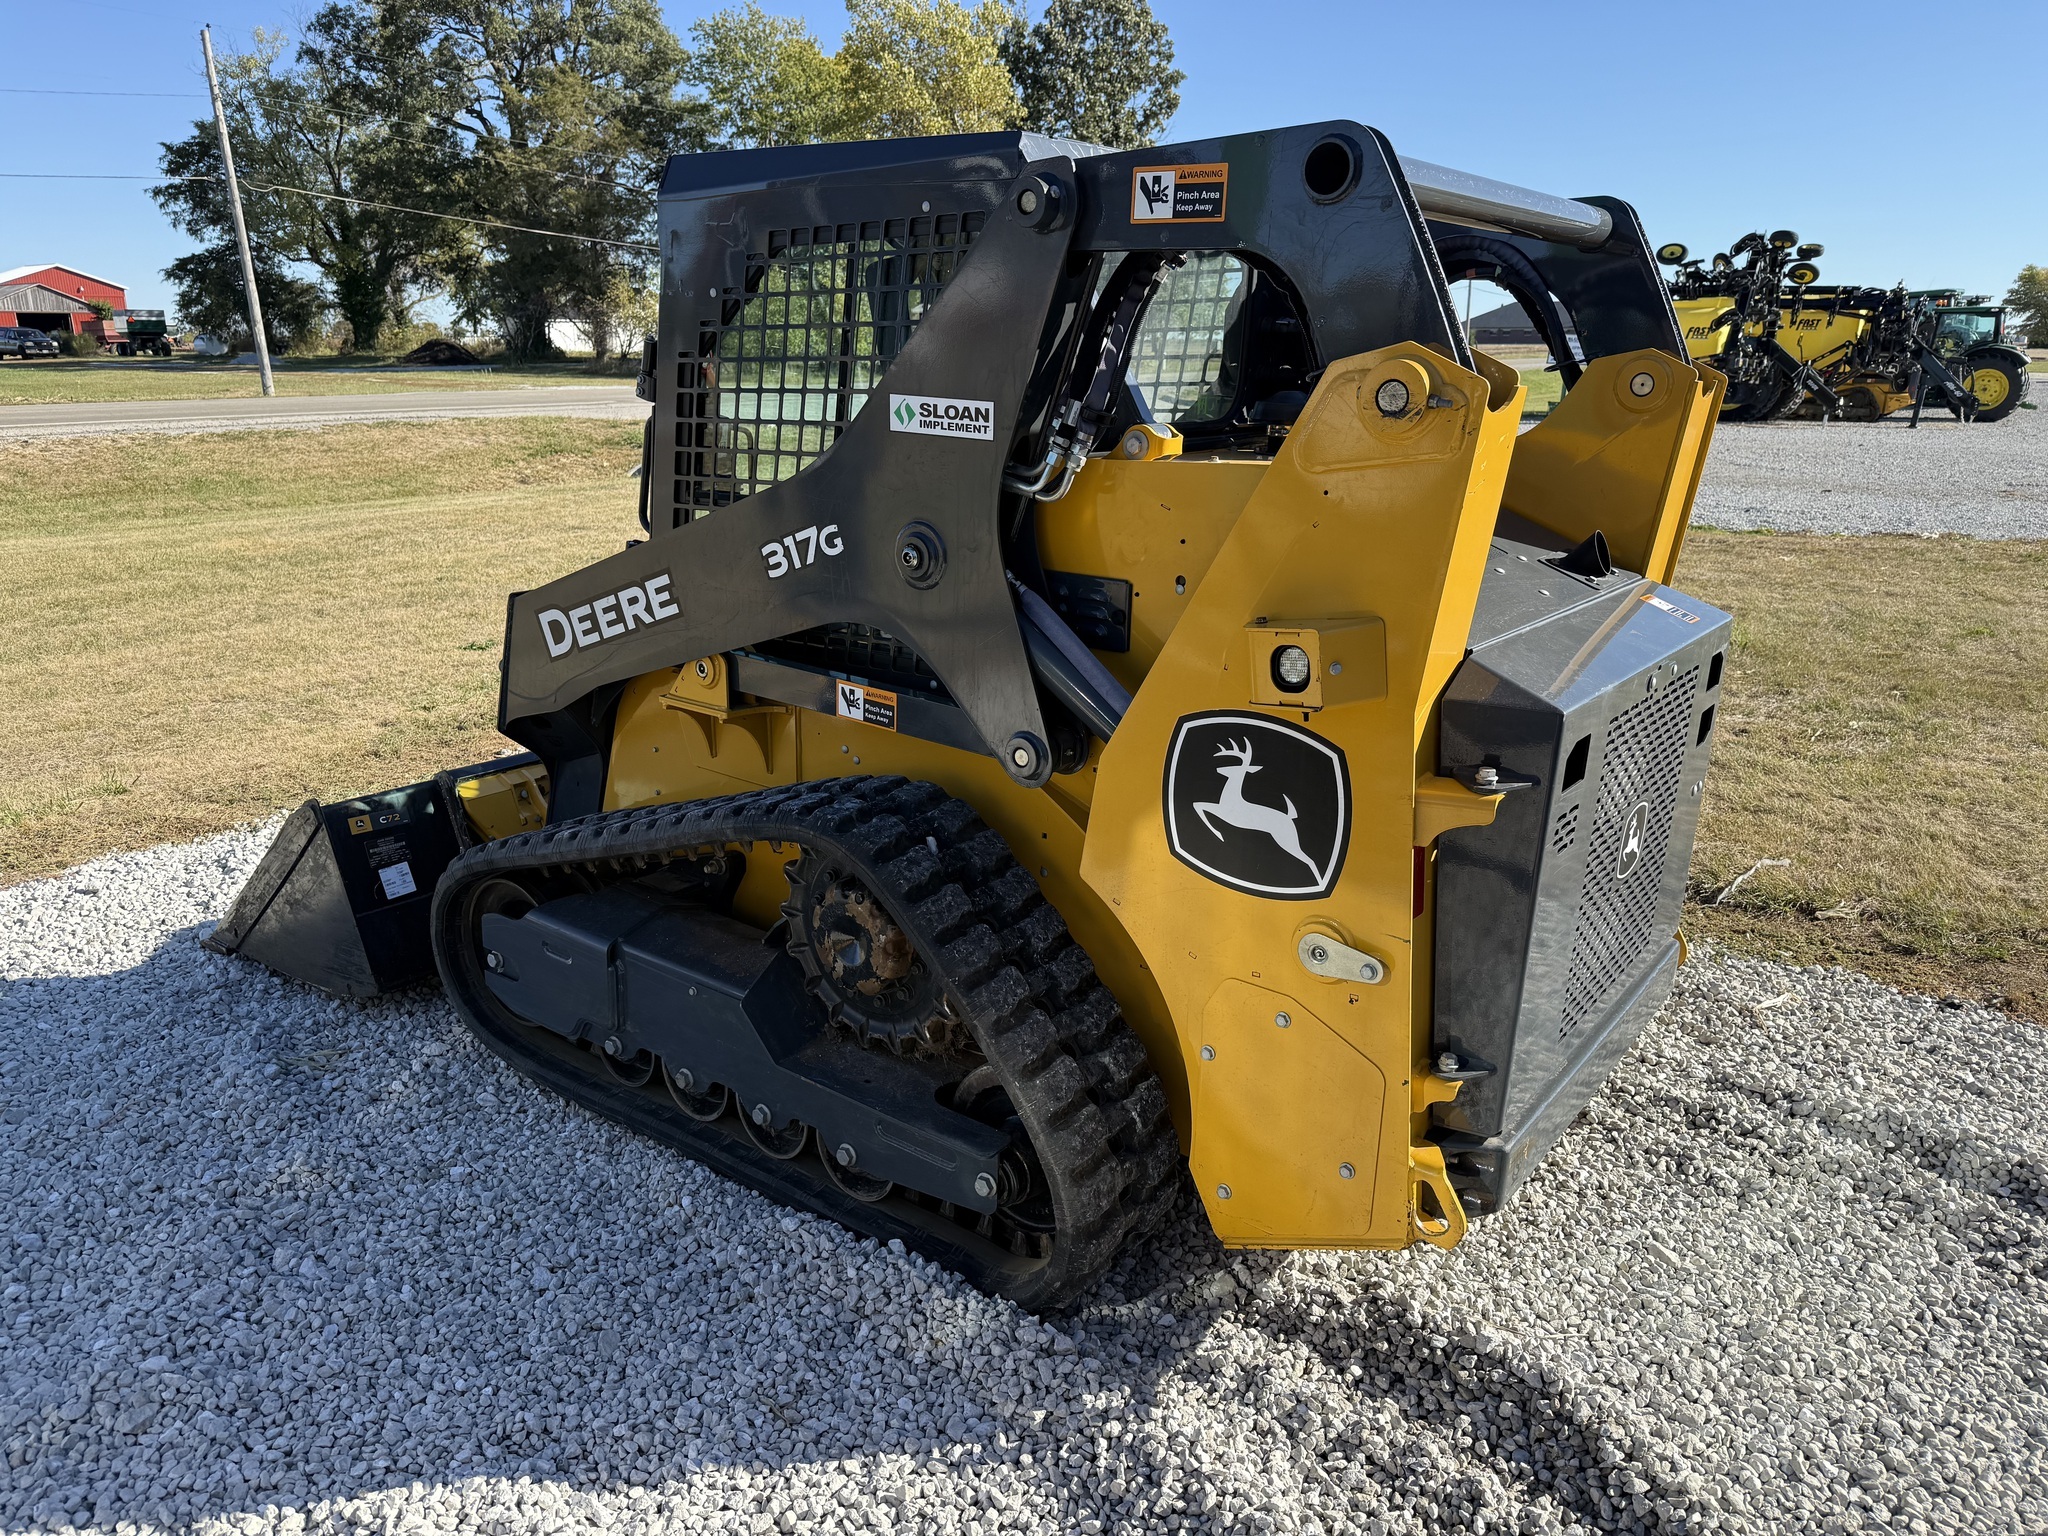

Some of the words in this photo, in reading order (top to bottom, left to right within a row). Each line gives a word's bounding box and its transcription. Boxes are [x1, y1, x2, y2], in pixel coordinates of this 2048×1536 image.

[1186, 169, 1223, 179] WARNING
[1176, 190, 1199, 200] Pinch
[1200, 190, 1220, 199] Area
[1176, 203, 1194, 213] Keep
[1194, 202, 1213, 212] Away
[1795, 318, 1822, 331] FAST
[918, 402, 990, 423] SLOAN
[919, 419, 990, 435] IMPLEMENT
[761, 524, 845, 579] 317G
[537, 573, 680, 658] DEERE
[870, 692, 894, 703] WARNING
[864, 703, 880, 714] Pinch
[880, 708, 893, 717] Area
[864, 712, 877, 720] Keep
[876, 715, 889, 724] Away
[379, 813, 401, 824] C72
